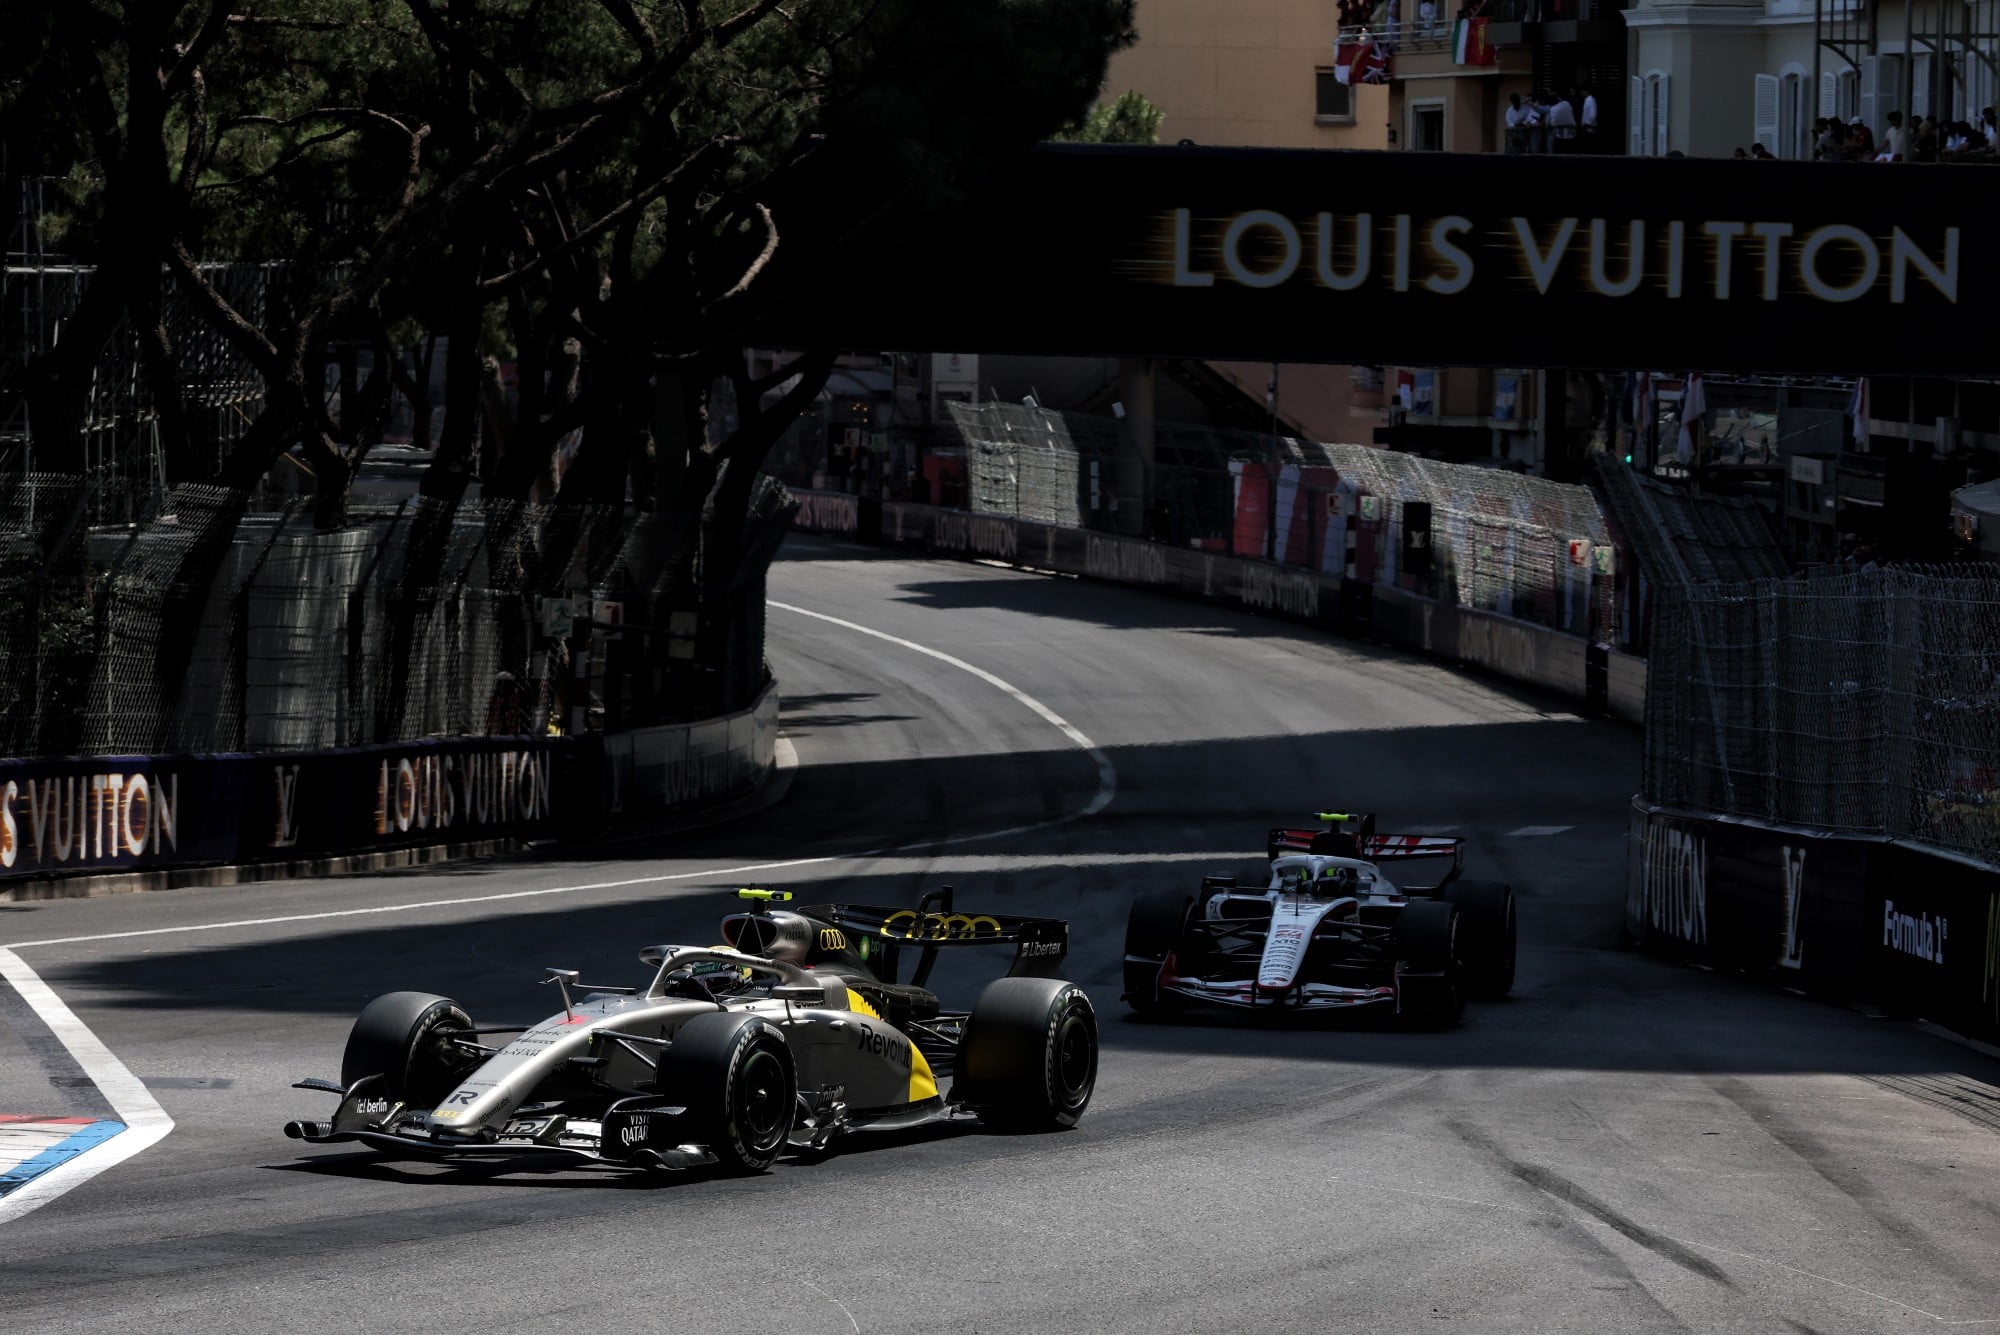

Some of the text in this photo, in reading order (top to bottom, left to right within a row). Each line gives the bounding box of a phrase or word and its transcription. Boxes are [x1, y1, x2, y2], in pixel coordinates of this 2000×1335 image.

[1173, 207, 1961, 305] LOUIS VUITTON
[29, 772, 178, 864] VUITTON
[379, 752, 455, 834] LOUIS
[458, 749, 551, 825] VUITTON
[1029, 941, 1062, 957] Libertex
[1883, 899, 1934, 962] Formula
[367, 1096, 388, 1113] berlin
[621, 1125, 649, 1147] QATAR
